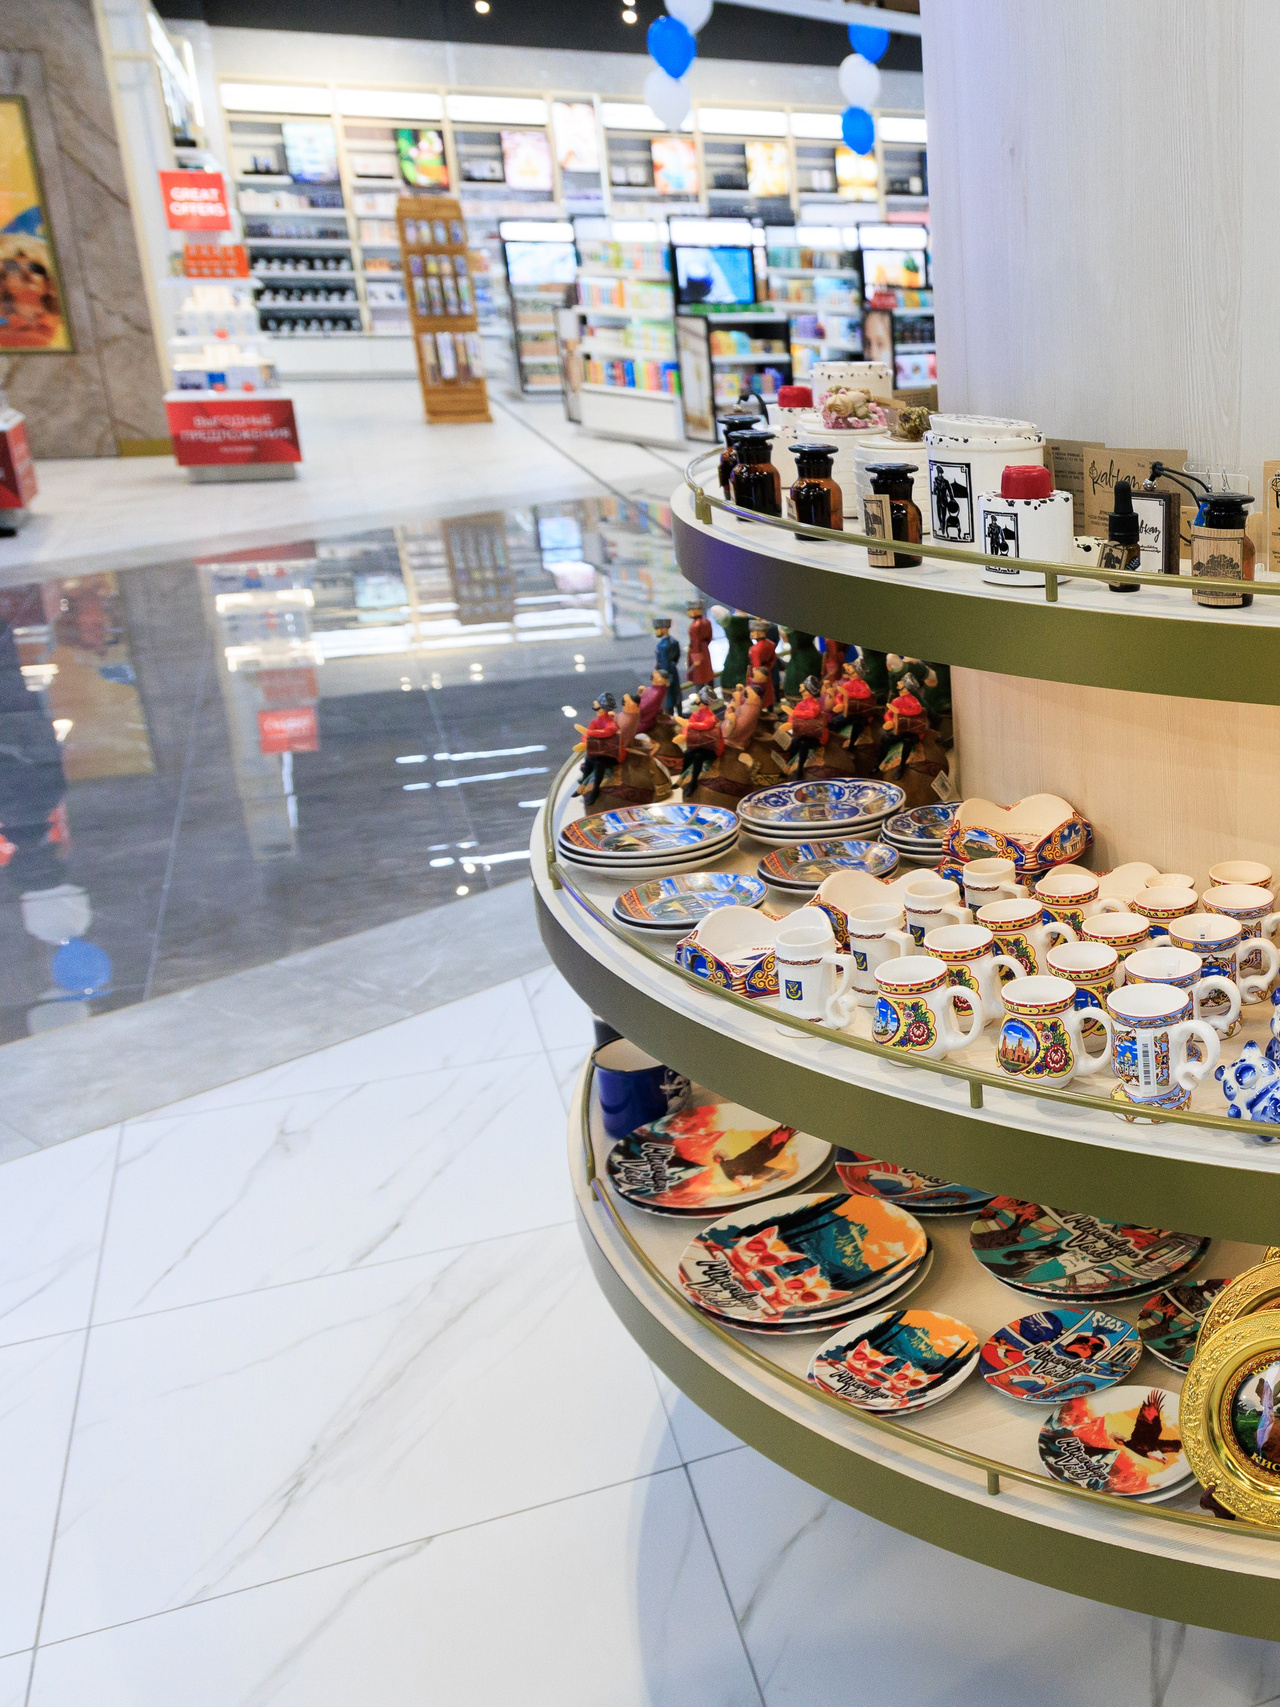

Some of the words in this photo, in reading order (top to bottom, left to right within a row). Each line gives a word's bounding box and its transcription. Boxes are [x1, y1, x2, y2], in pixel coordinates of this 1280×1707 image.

[169, 187, 220, 201] GREAT
[169, 202, 227, 217] OFFERS
[1062, 1213, 1141, 1260] Mineralnye
[1065, 1232, 1117, 1264] Vody
[1024, 1344, 1094, 1374] Mineralnye
[1031, 1360, 1077, 1383] Vody
